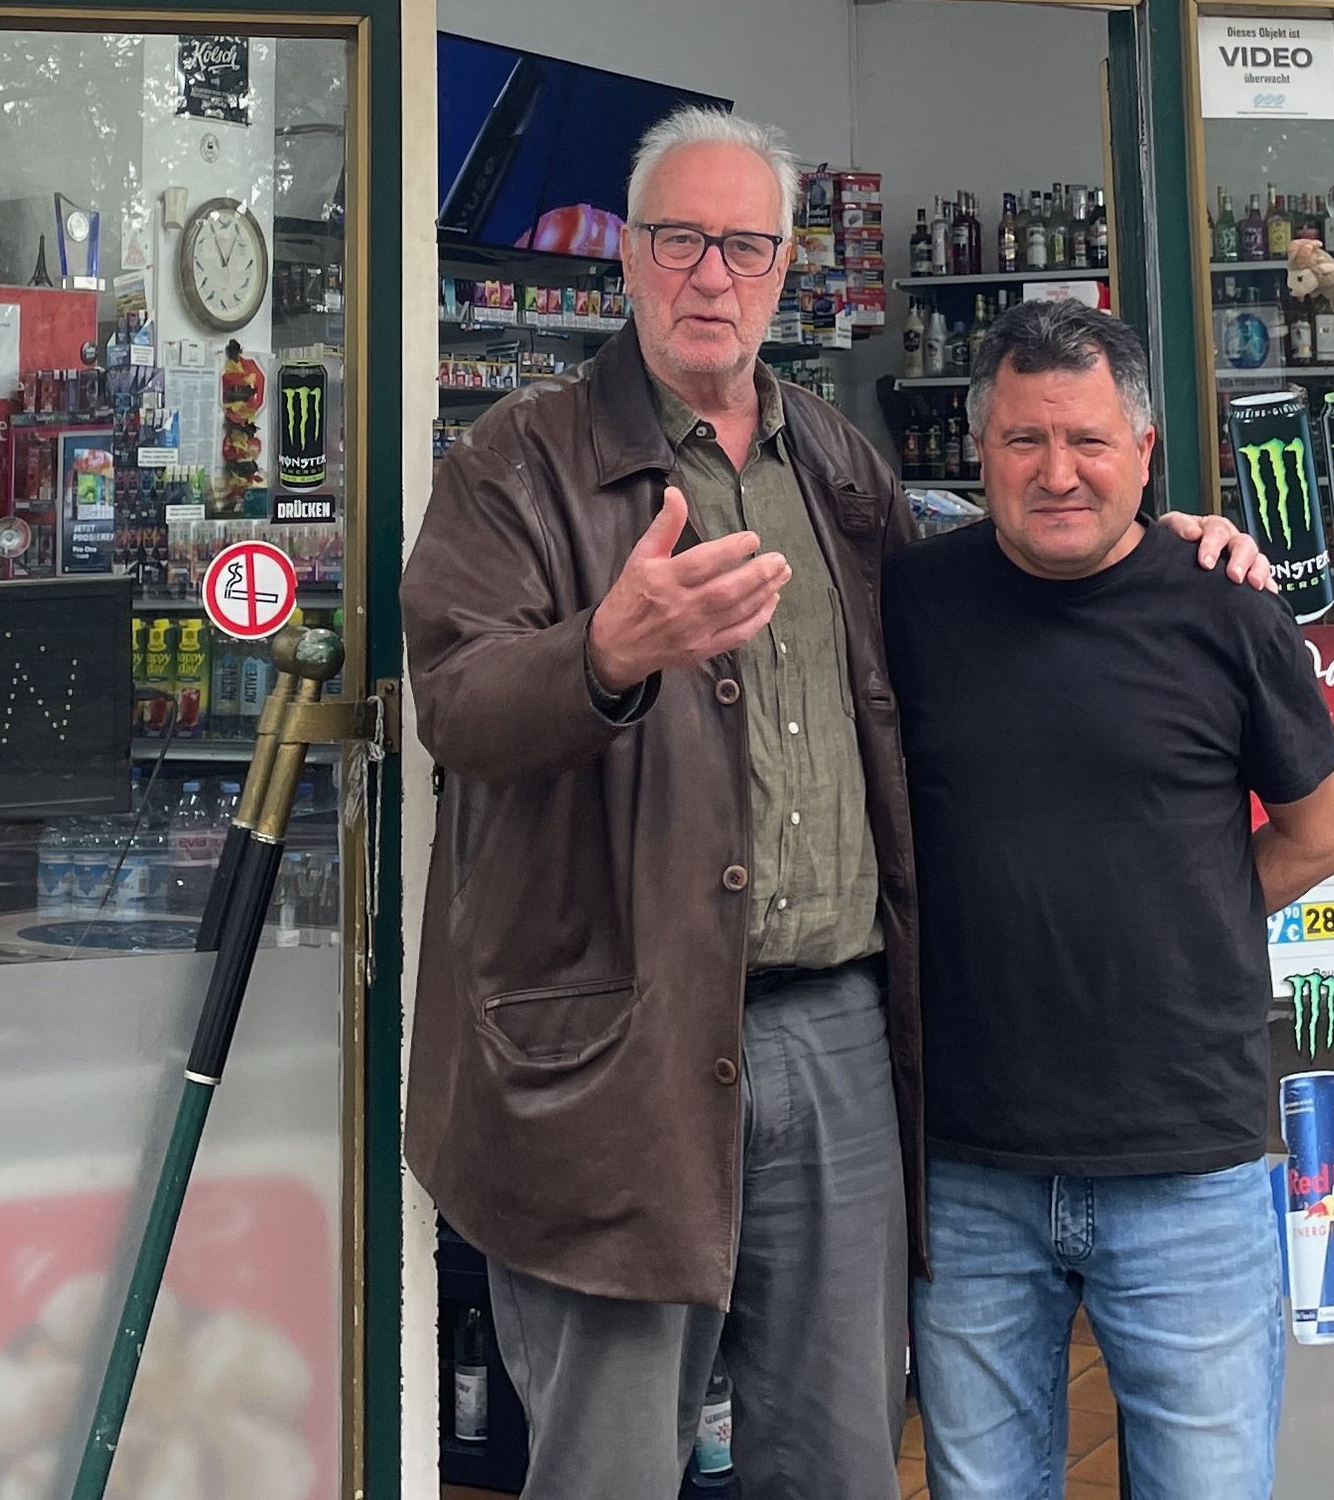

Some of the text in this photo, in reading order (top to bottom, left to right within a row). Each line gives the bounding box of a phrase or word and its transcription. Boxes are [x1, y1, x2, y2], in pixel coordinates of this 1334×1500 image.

[1227, 27, 1300, 40] Dieses Objekt ist
[1219, 46, 1313, 68] VIDEO
[1244, 73, 1291, 84] überwacht
[278, 500, 330, 518] DRÜCKEN
[1287, 1162, 1329, 1197] Red
